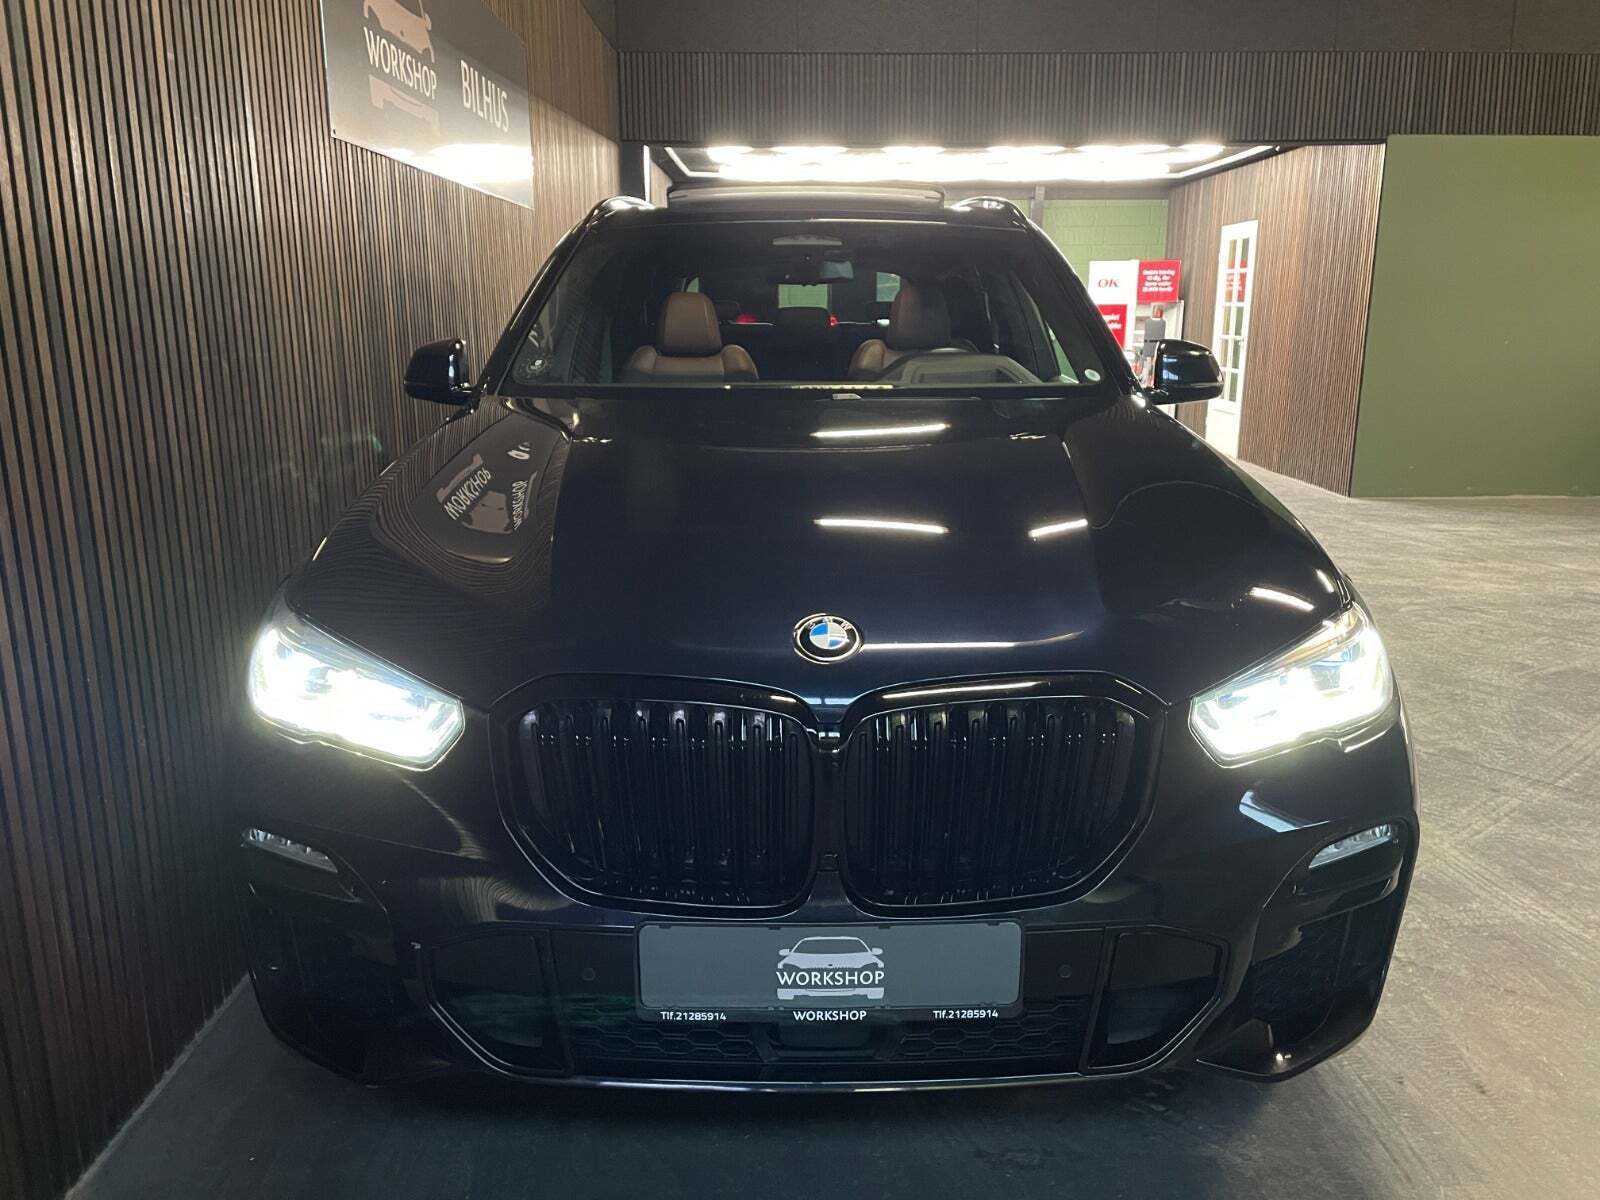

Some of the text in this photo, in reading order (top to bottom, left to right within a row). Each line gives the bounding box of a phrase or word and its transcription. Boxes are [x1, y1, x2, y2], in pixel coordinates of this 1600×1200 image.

[363, 26, 437, 99] WORKSHOP
[460, 59, 509, 133] BILHUS
[1098, 278, 1119, 288] OK
[776, 971, 885, 987] WORKSHOP
[660, 1011, 727, 1021] Tlf.21285914
[792, 1010, 867, 1021] WORKSHOP
[932, 1009, 999, 1019] Tlf.21285914
